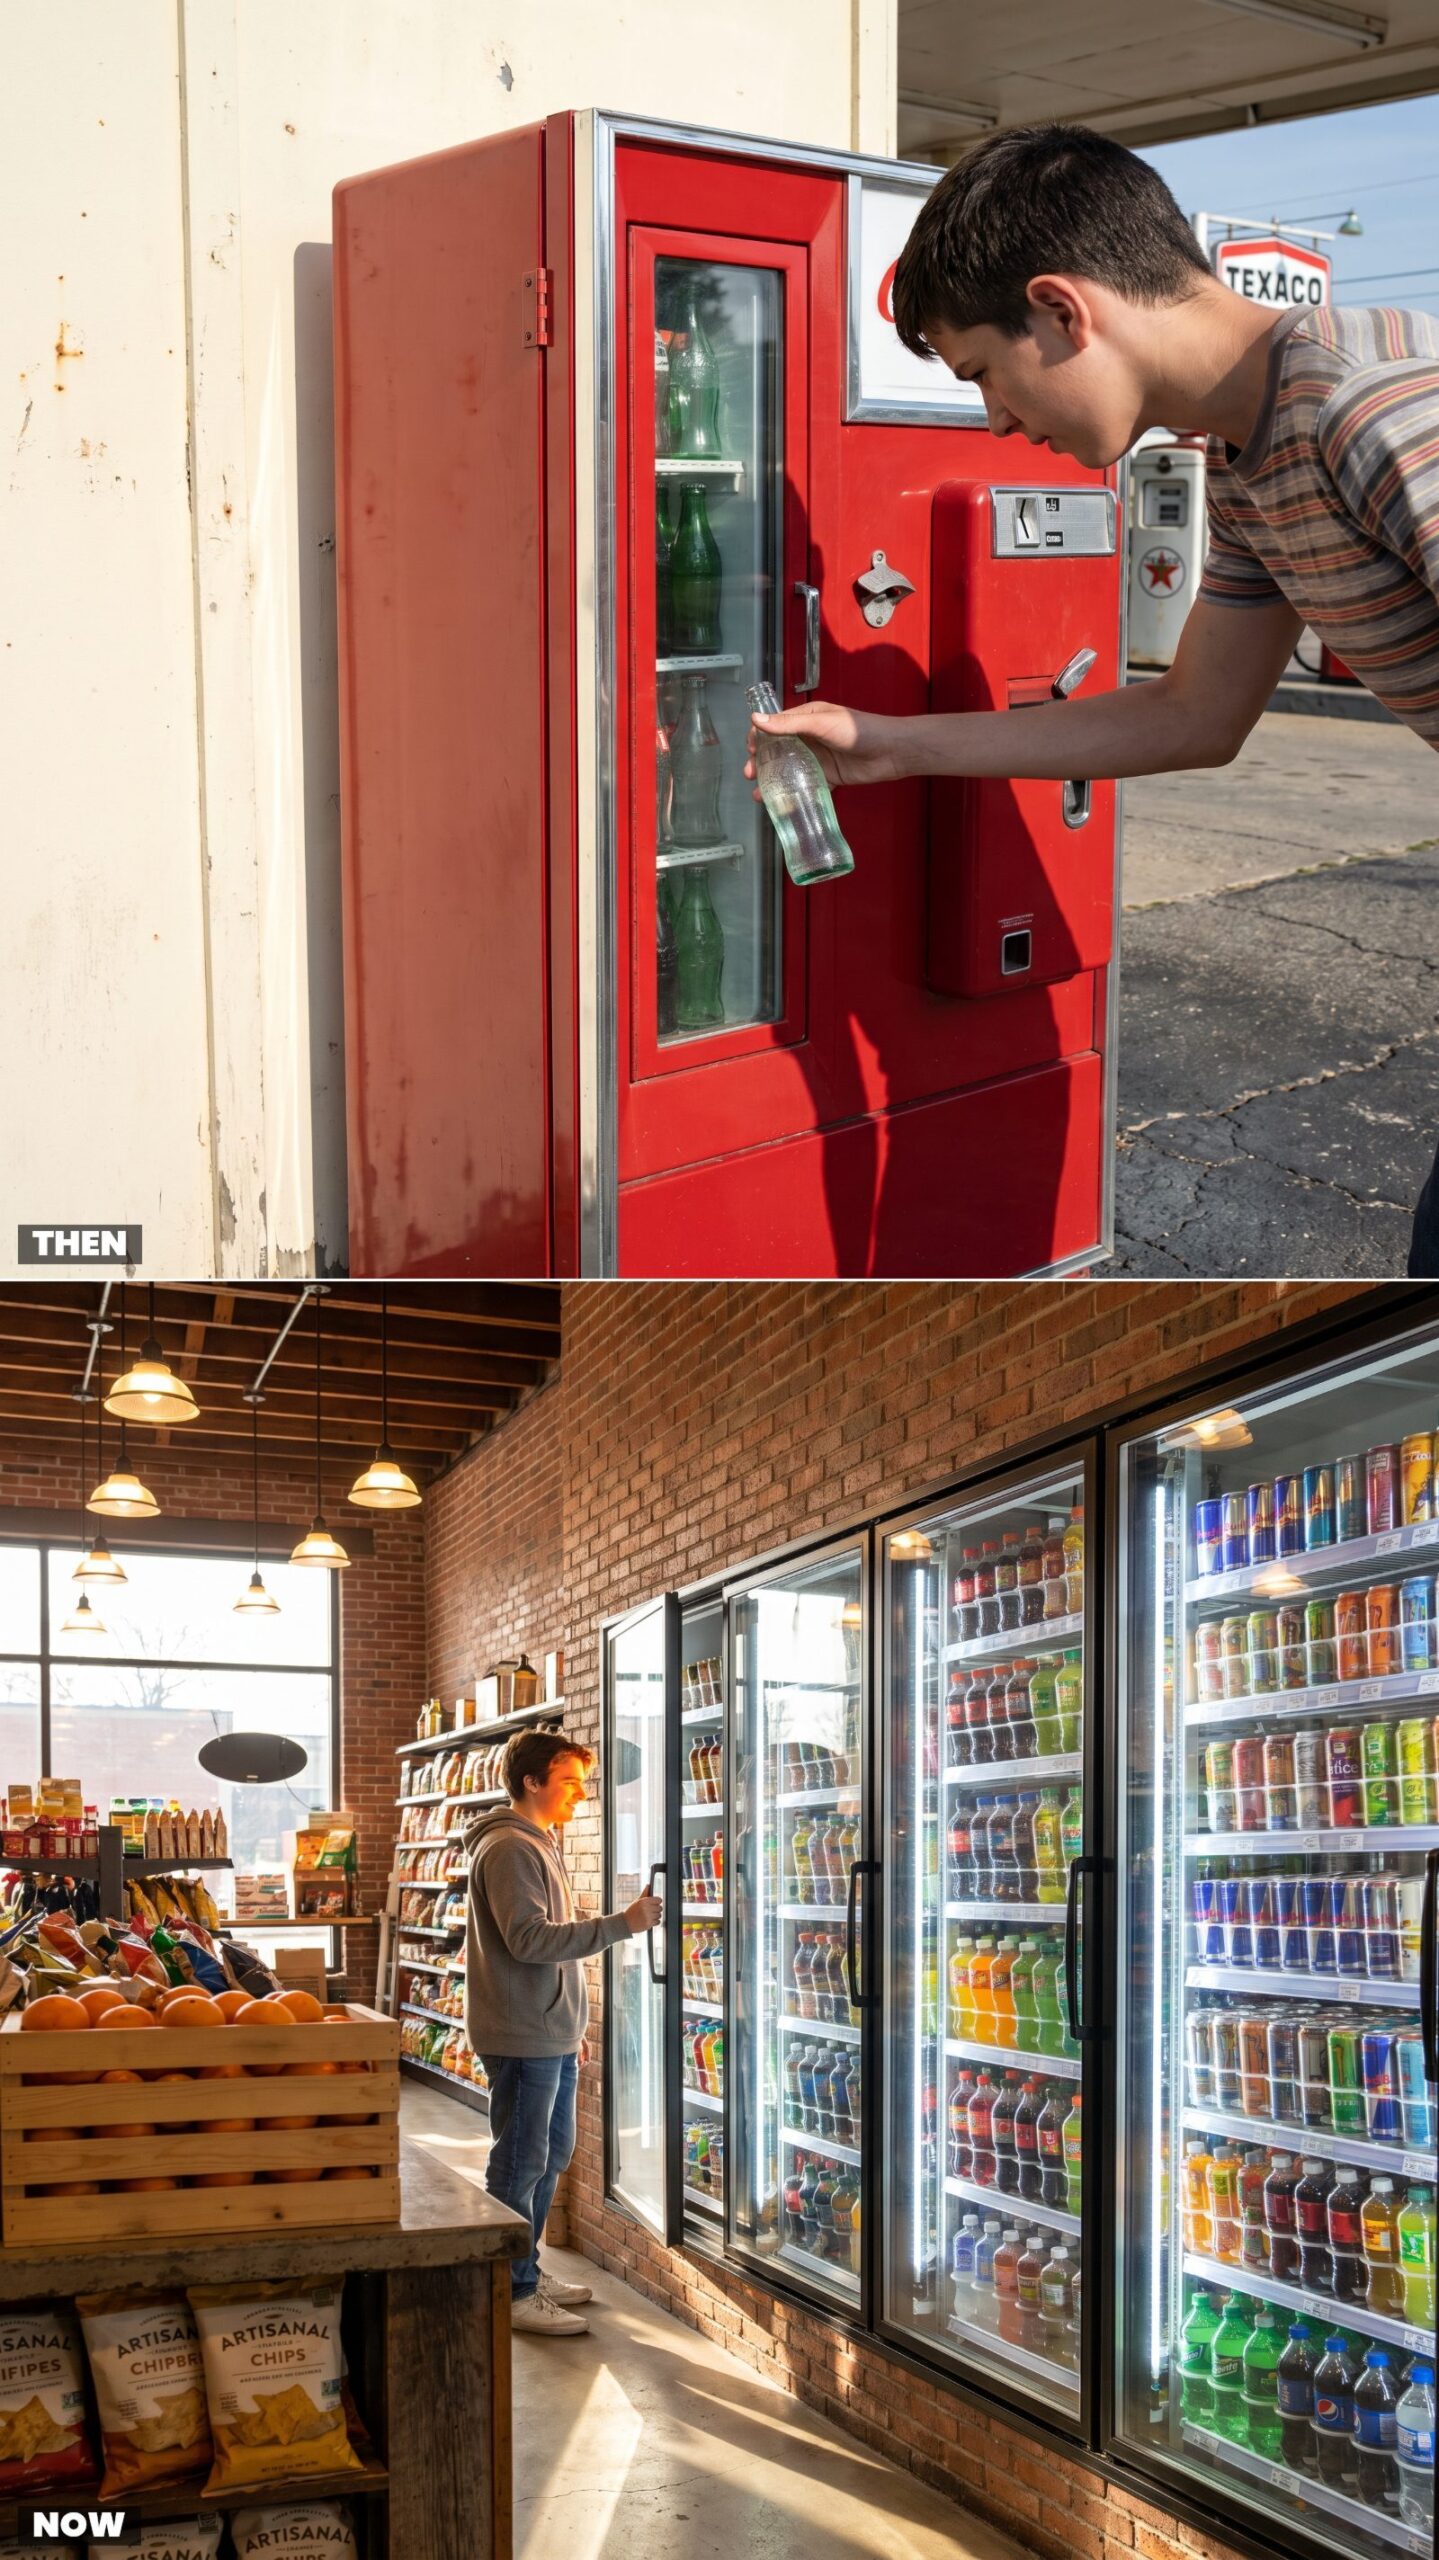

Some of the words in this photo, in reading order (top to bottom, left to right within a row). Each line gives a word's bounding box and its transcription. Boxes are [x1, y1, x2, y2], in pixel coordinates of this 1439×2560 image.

[1226, 266, 1322, 305] TEXACO
[221, 2321, 330, 2352] ARTISANAL
[250, 2348, 306, 2367] CHIPS
[245, 2525, 351, 2554] ARTISANAL
